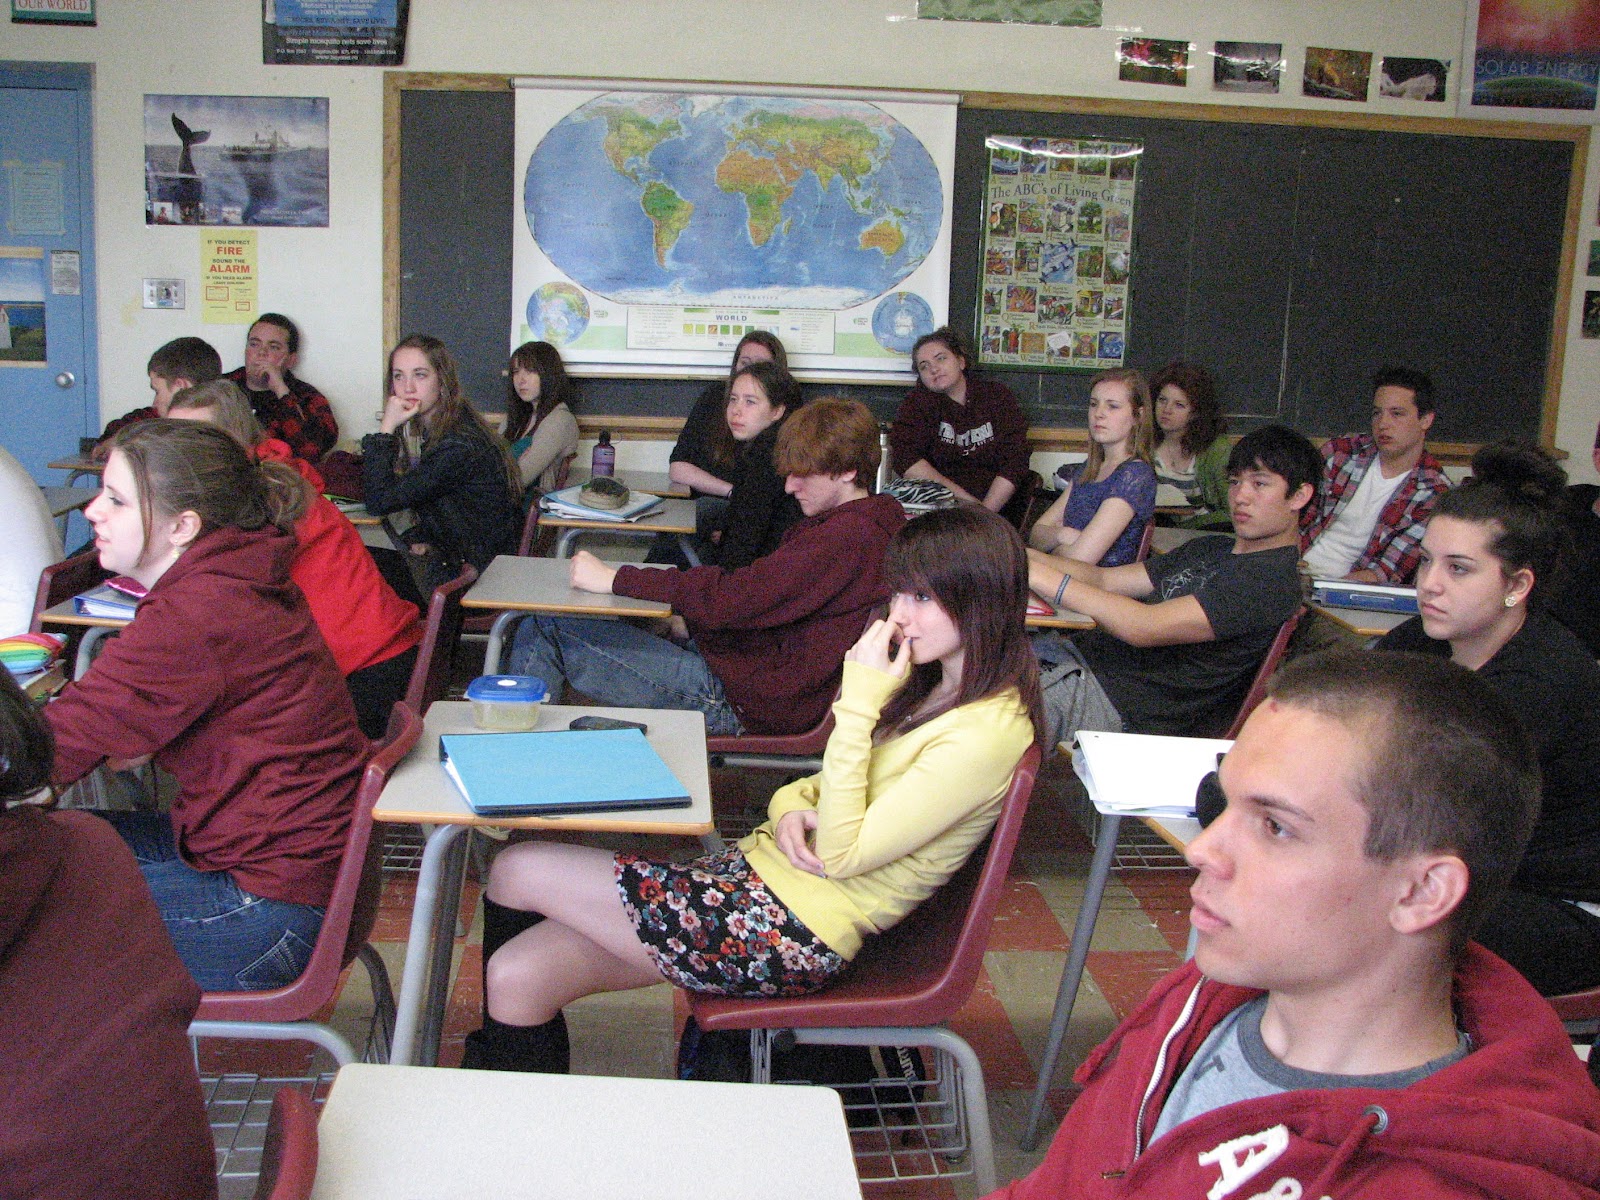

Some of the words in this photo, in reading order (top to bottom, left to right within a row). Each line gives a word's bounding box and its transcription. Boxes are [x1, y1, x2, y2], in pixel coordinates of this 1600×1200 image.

[18, 0, 43, 9] OUR
[47, 0, 88, 11] WORLD
[1476, 59, 1530, 77] SOLAR
[990, 187, 1011, 198] The
[1013, 183, 1047, 195] ABC's
[1051, 184, 1062, 194] of
[1065, 184, 1098, 201] Living
[1101, 189, 1131, 206] Green
[216, 246, 243, 255] FIRE
[209, 264, 250, 273] ALARM
